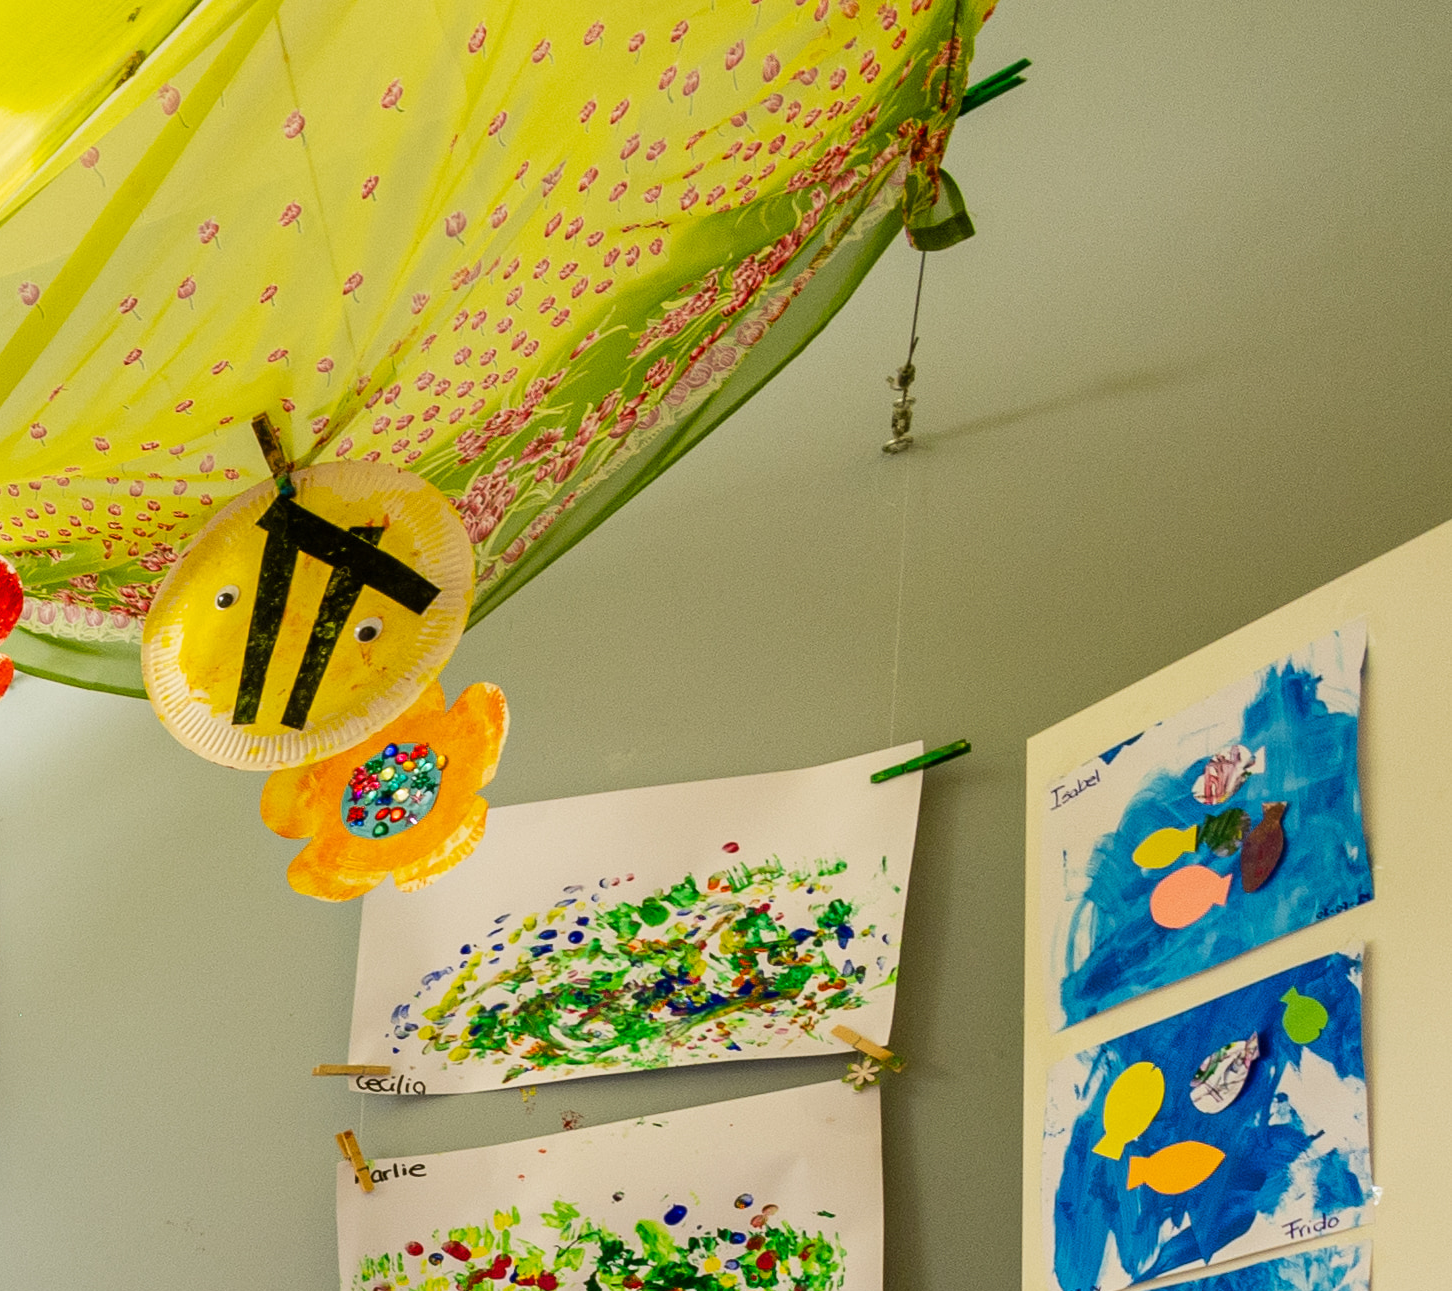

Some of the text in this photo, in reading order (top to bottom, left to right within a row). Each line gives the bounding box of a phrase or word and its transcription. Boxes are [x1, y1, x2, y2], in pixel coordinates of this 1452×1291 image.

[1050, 769, 1100, 811] Isabel
[356, 1074, 426, 1095] Cecilia
[355, 1163, 427, 1184] arlie
[1282, 1213, 1340, 1240] Frido
